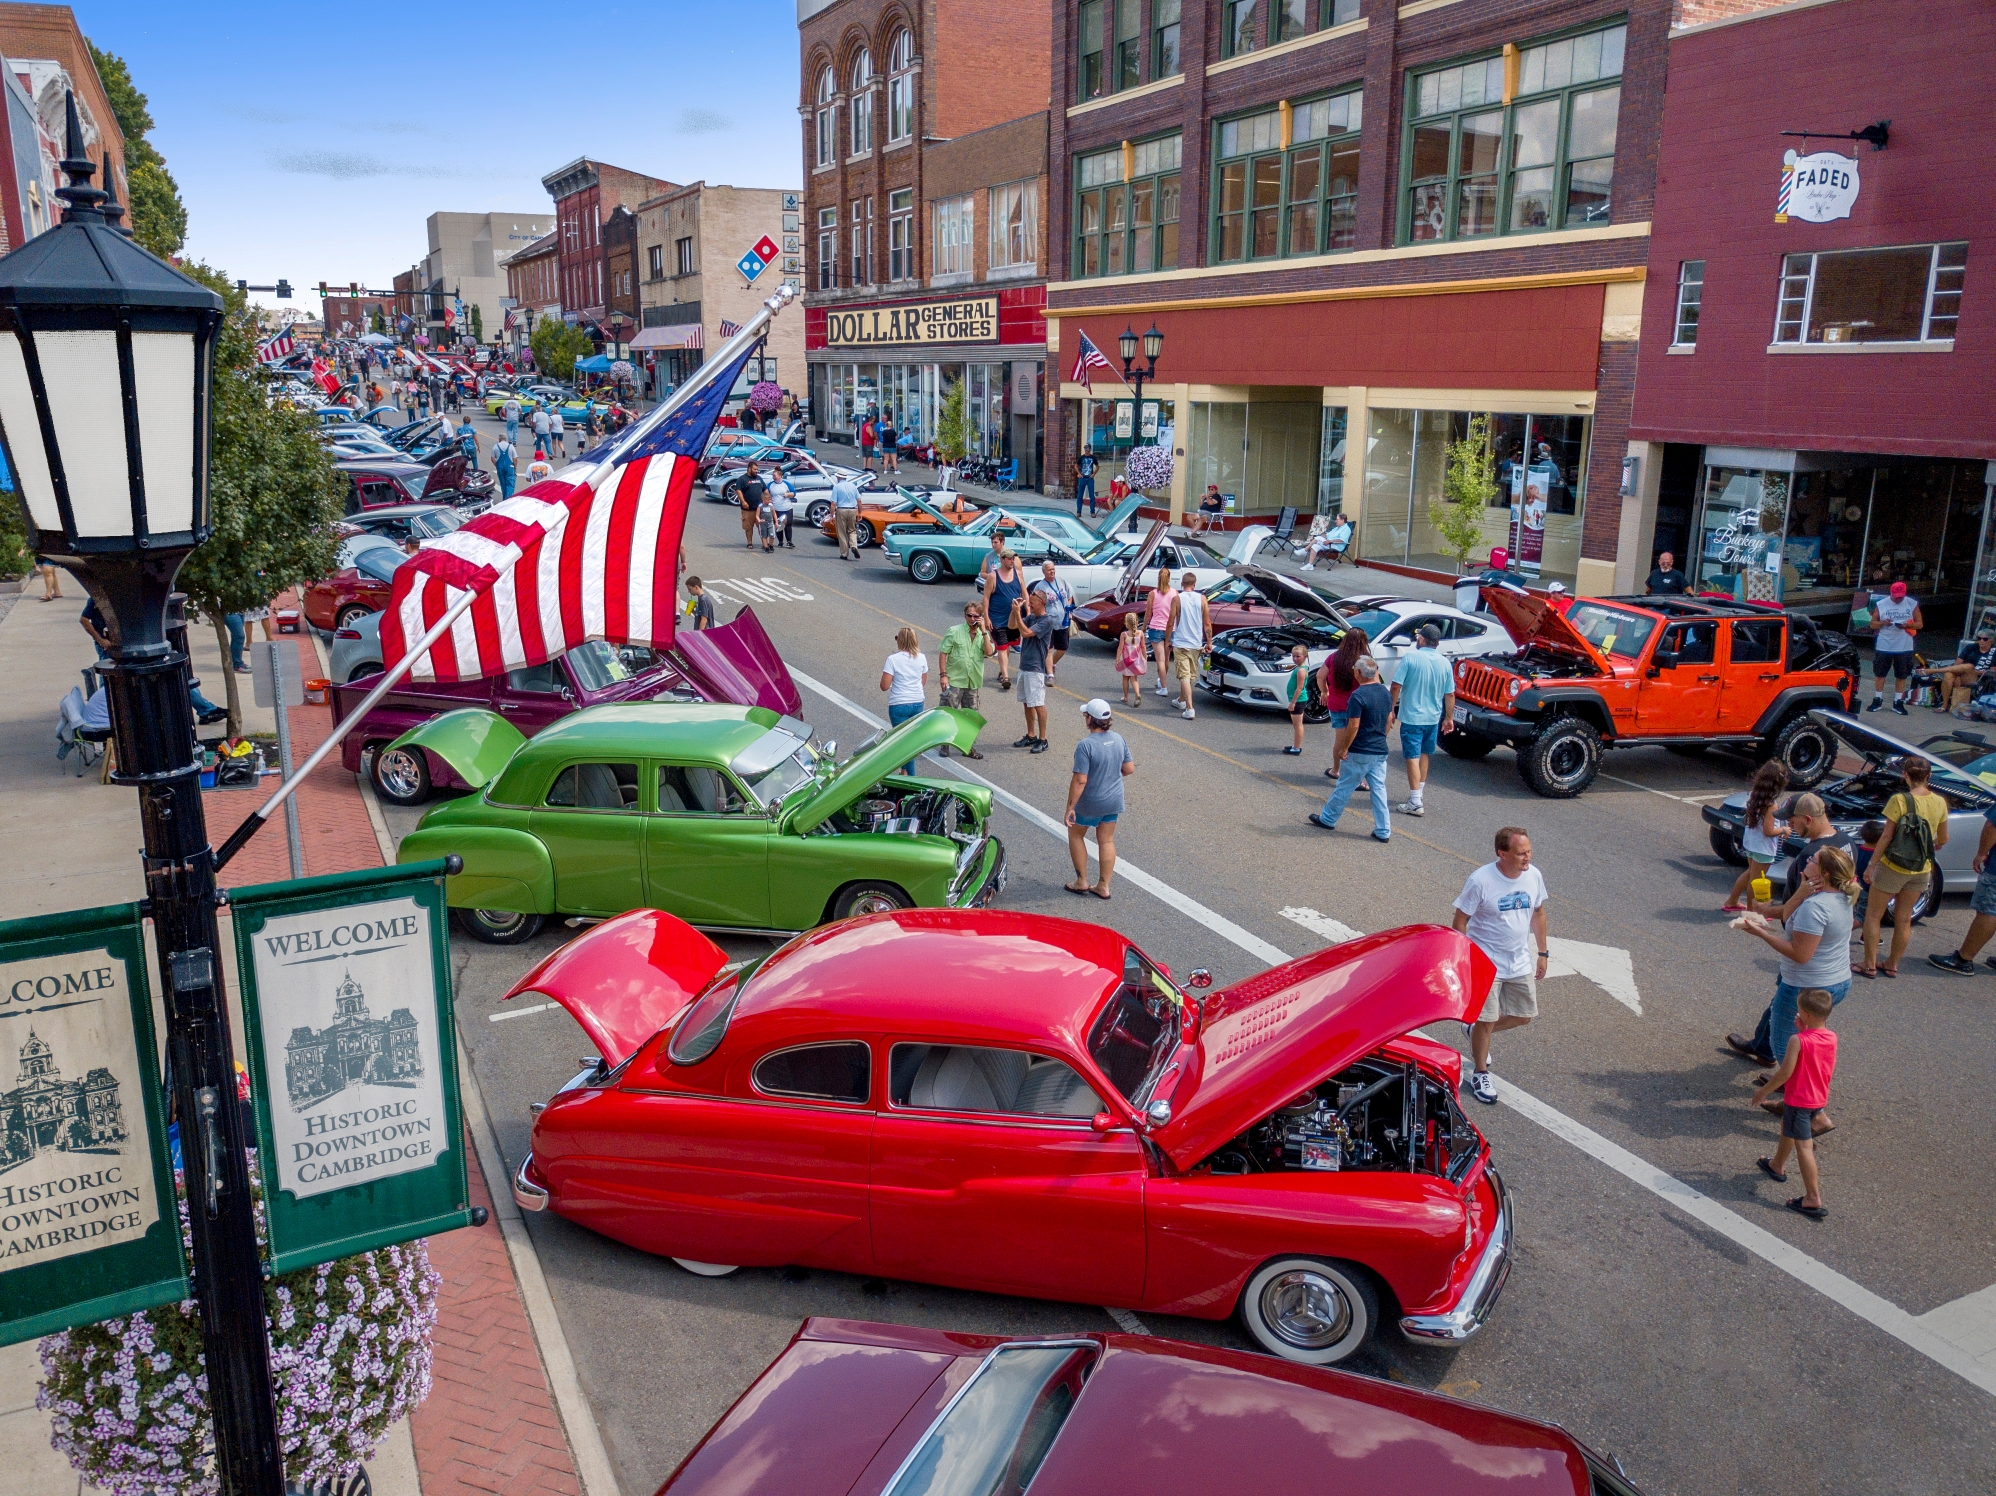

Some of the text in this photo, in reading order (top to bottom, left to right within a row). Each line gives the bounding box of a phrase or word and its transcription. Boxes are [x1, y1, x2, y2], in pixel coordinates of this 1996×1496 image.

[1796, 168, 1850, 190] FADED
[828, 302, 996, 343] DOLLAR GENERAL
[927, 320, 991, 339] STORES
[1713, 526, 1766, 553] Buckeye
[1718, 546, 1757, 564] Tours
[264, 915, 419, 958] WELCOME
[303, 1099, 418, 1137] HISTORIC
[291, 1117, 432, 1162] DOWNTOWN
[297, 1139, 433, 1183] CAMBRIDGE
[0, 1211, 143, 1259] AMBRIDGE
